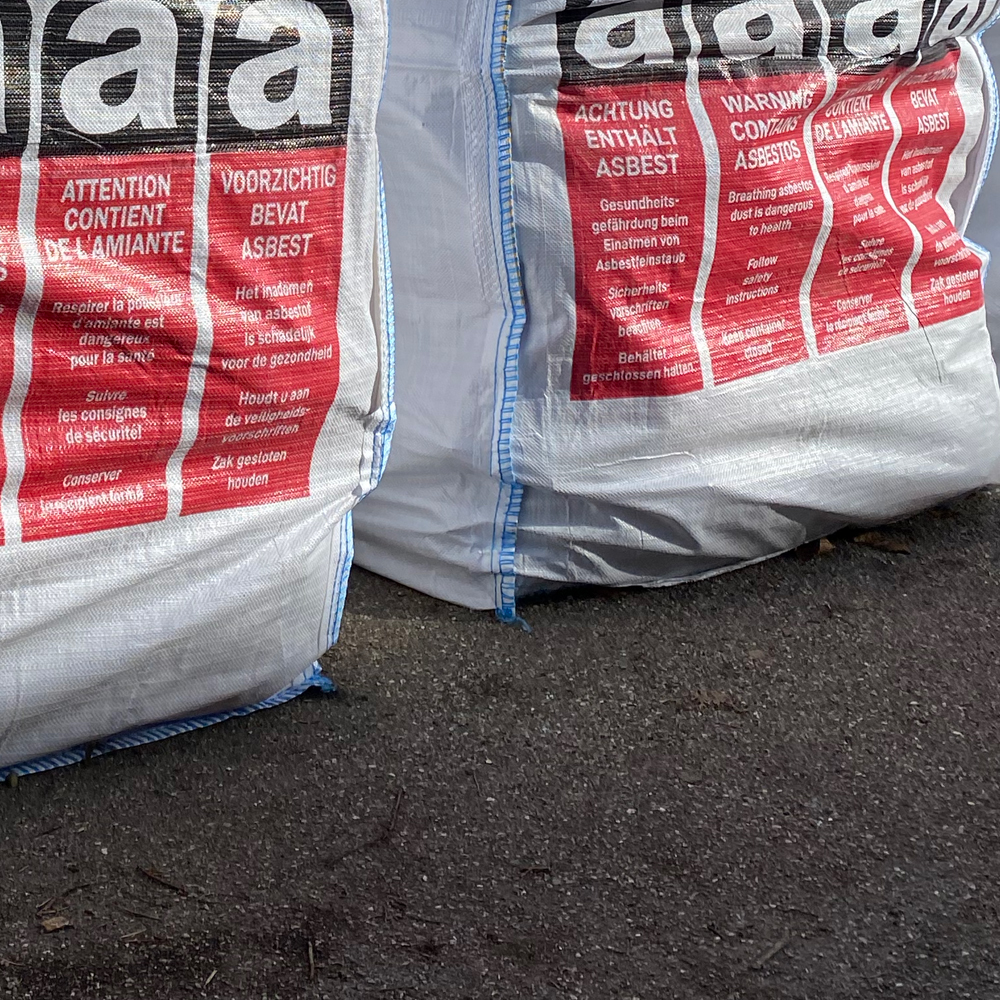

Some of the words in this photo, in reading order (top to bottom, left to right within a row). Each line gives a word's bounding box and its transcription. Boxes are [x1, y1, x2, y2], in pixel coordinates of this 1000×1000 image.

[720, 89, 814, 115] WARNING
[825, 94, 873, 118] CONTIENT
[910, 88, 939, 109] BEVAT
[575, 100, 674, 123] ACHTUNG
[730, 115, 801, 142] CONTAINS
[814, 123, 833, 143] DE
[917, 112, 950, 135] ASBEST
[585, 124, 678, 150] ENTHÄLT
[597, 153, 680, 178] ASBEST
[734, 140, 801, 171] ASBESTOS
[61, 174, 171, 203] ATTENTION
[220, 164, 338, 194] VOORZICHTIG
[728, 187, 777, 203] Breathing
[778, 180, 814, 197] asbestos
[250, 201, 309, 226] BEVAT
[600, 196, 680, 212] Gesundheits-
[730, 207, 753, 222] dust
[754, 205, 763, 218] is
[764, 199, 814, 217] dangerous
[64, 203, 166, 231] CONTIENT
[592, 217, 658, 234] gefährdung
[661, 214, 689, 227] beim
[749, 224, 758, 236] to
[760, 219, 792, 235] health
[241, 233, 313, 260] ASBEST
[603, 237, 658, 252] Einatmen
[660, 234, 680, 247] von
[596, 252, 686, 272] Asbestfeinstaub
[747, 255, 778, 270] Follow
[742, 271, 773, 286] safety
[235, 284, 259, 300] Het
[608, 280, 670, 300] Sicherheits-
[726, 285, 779, 305] instructions
[943, 288, 971, 305] houden
[52, 299, 109, 315] Respirer
[112, 297, 124, 312] la
[241, 309, 262, 322] van
[610, 299, 670, 320] vorschriften
[144, 315, 165, 328] est
[79, 333, 150, 347] dangereux
[258, 325, 316, 343] schadelijk
[70, 353, 99, 370] pour
[102, 350, 114, 364] la
[117, 348, 155, 362] santé
[221, 357, 250, 370] voor
[252, 354, 267, 368] de
[269, 344, 333, 369] gezondheid
[619, 348, 667, 364] Behälter
[583, 369, 661, 386] geschlossen
[663, 362, 694, 379] halten
[86, 390, 127, 402] Suivre
[239, 389, 279, 406] Houdt
[280, 391, 288, 404] u
[290, 388, 310, 402] aan
[58, 408, 78, 423] les
[81, 405, 147, 423] consignes
[225, 412, 241, 427] de
[65, 428, 83, 444] de
[222, 423, 300, 443] voorschriften
[211, 455, 233, 470] Zak
[237, 450, 287, 469] gesloten
[63, 469, 122, 488] Conserver
[227, 473, 269, 490] houden
